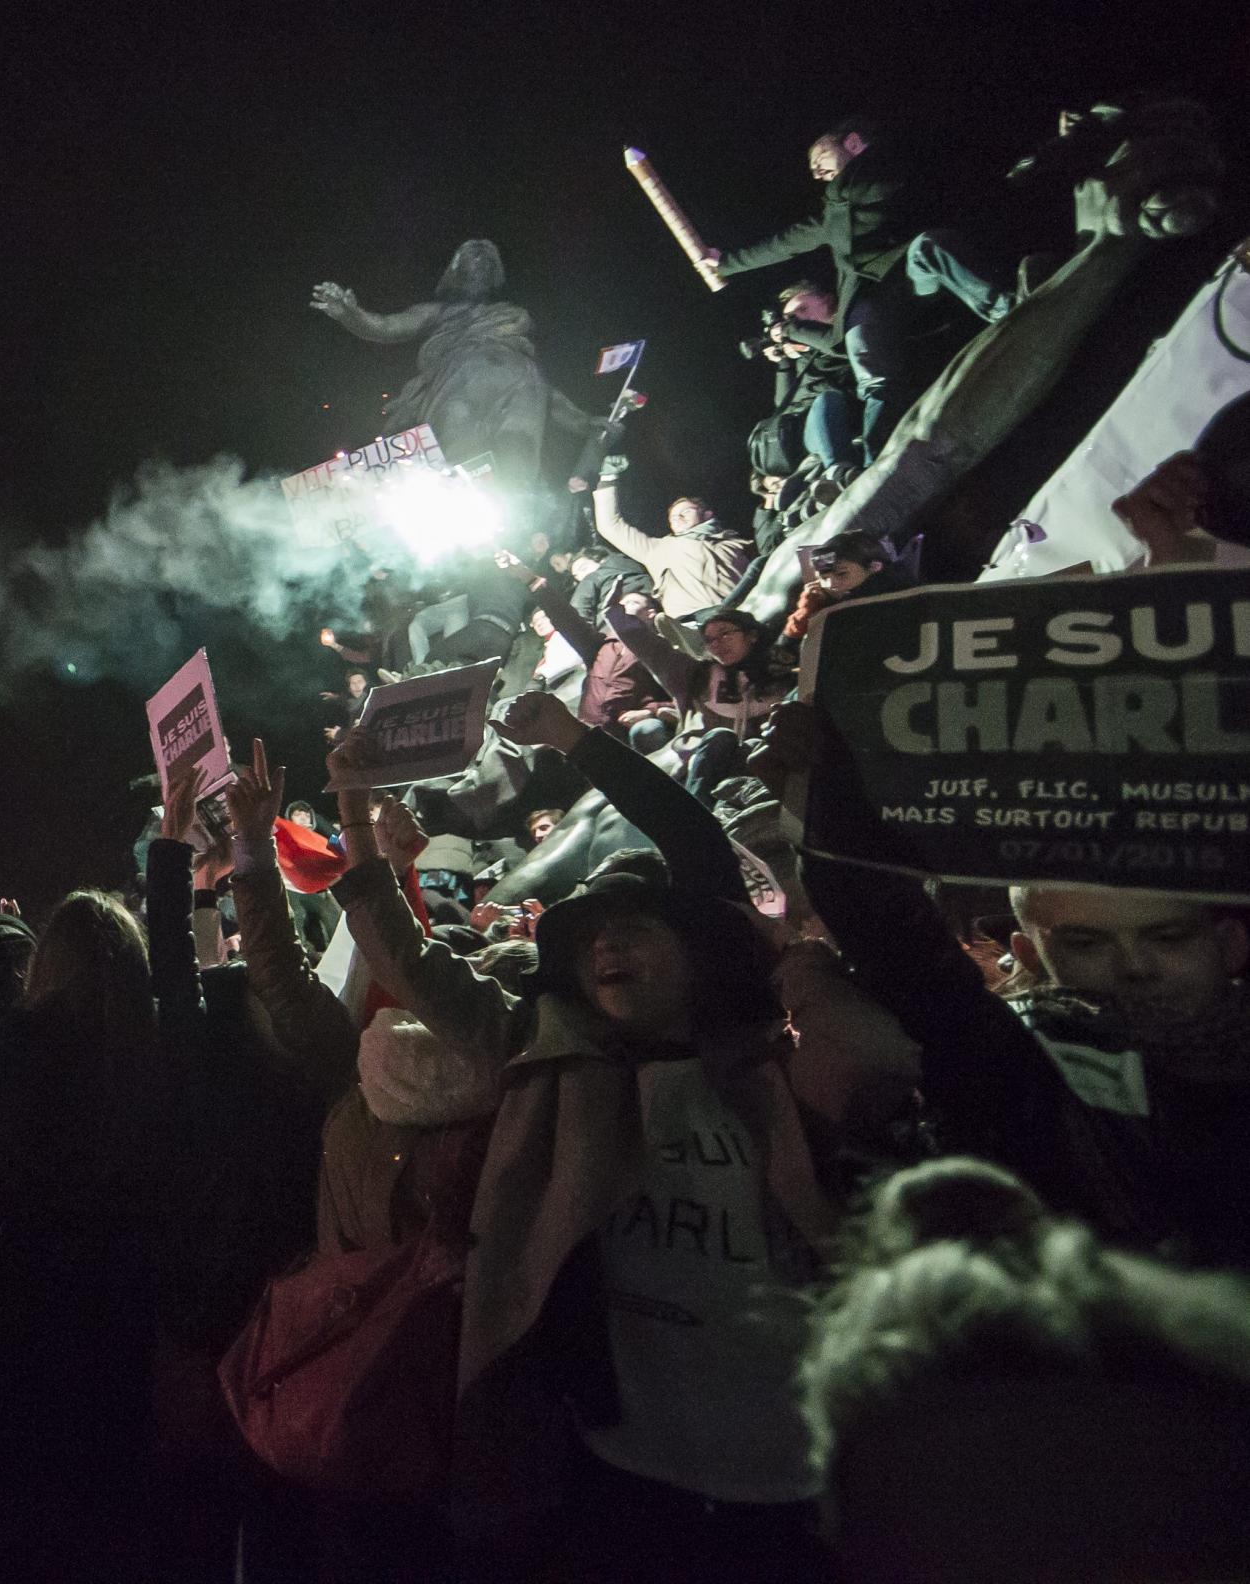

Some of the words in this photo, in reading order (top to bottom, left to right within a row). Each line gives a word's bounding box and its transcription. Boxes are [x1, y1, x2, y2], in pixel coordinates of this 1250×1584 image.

[346, 433, 408, 474] PLUS
[883, 617, 1019, 673] JE
[161, 728, 177, 749] JE
[177, 700, 207, 733] SUIS
[881, 671, 1250, 755] CHARL
[881, 805, 956, 826] MAIS
[974, 808, 1116, 829] SURTOUT
